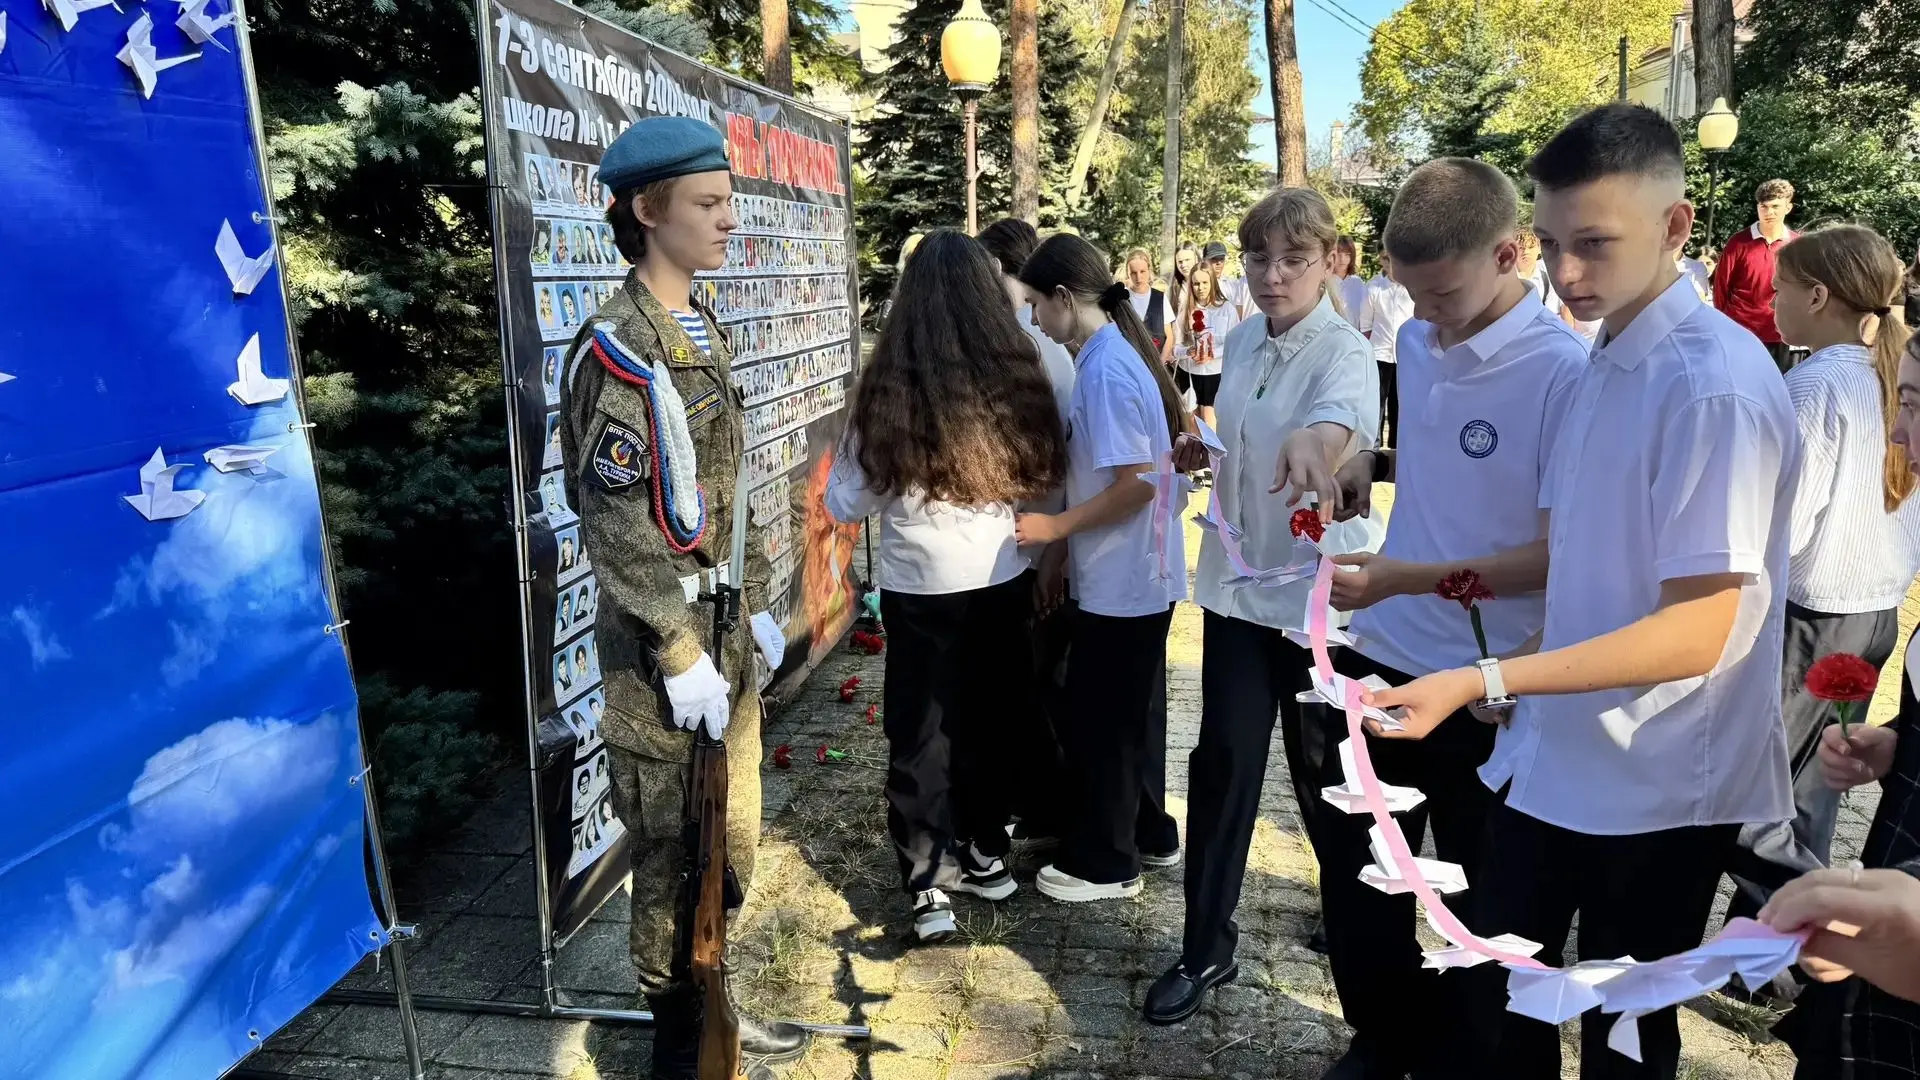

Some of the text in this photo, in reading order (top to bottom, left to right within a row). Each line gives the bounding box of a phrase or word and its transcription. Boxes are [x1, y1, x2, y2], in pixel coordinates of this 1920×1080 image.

[495, 14, 540, 74] 1-3
[541, 37, 643, 109] сентября
[502, 96, 575, 142] школа
[725, 112, 768, 180] МЫ
[608, 426, 639, 446] ВПК ПОСТ
